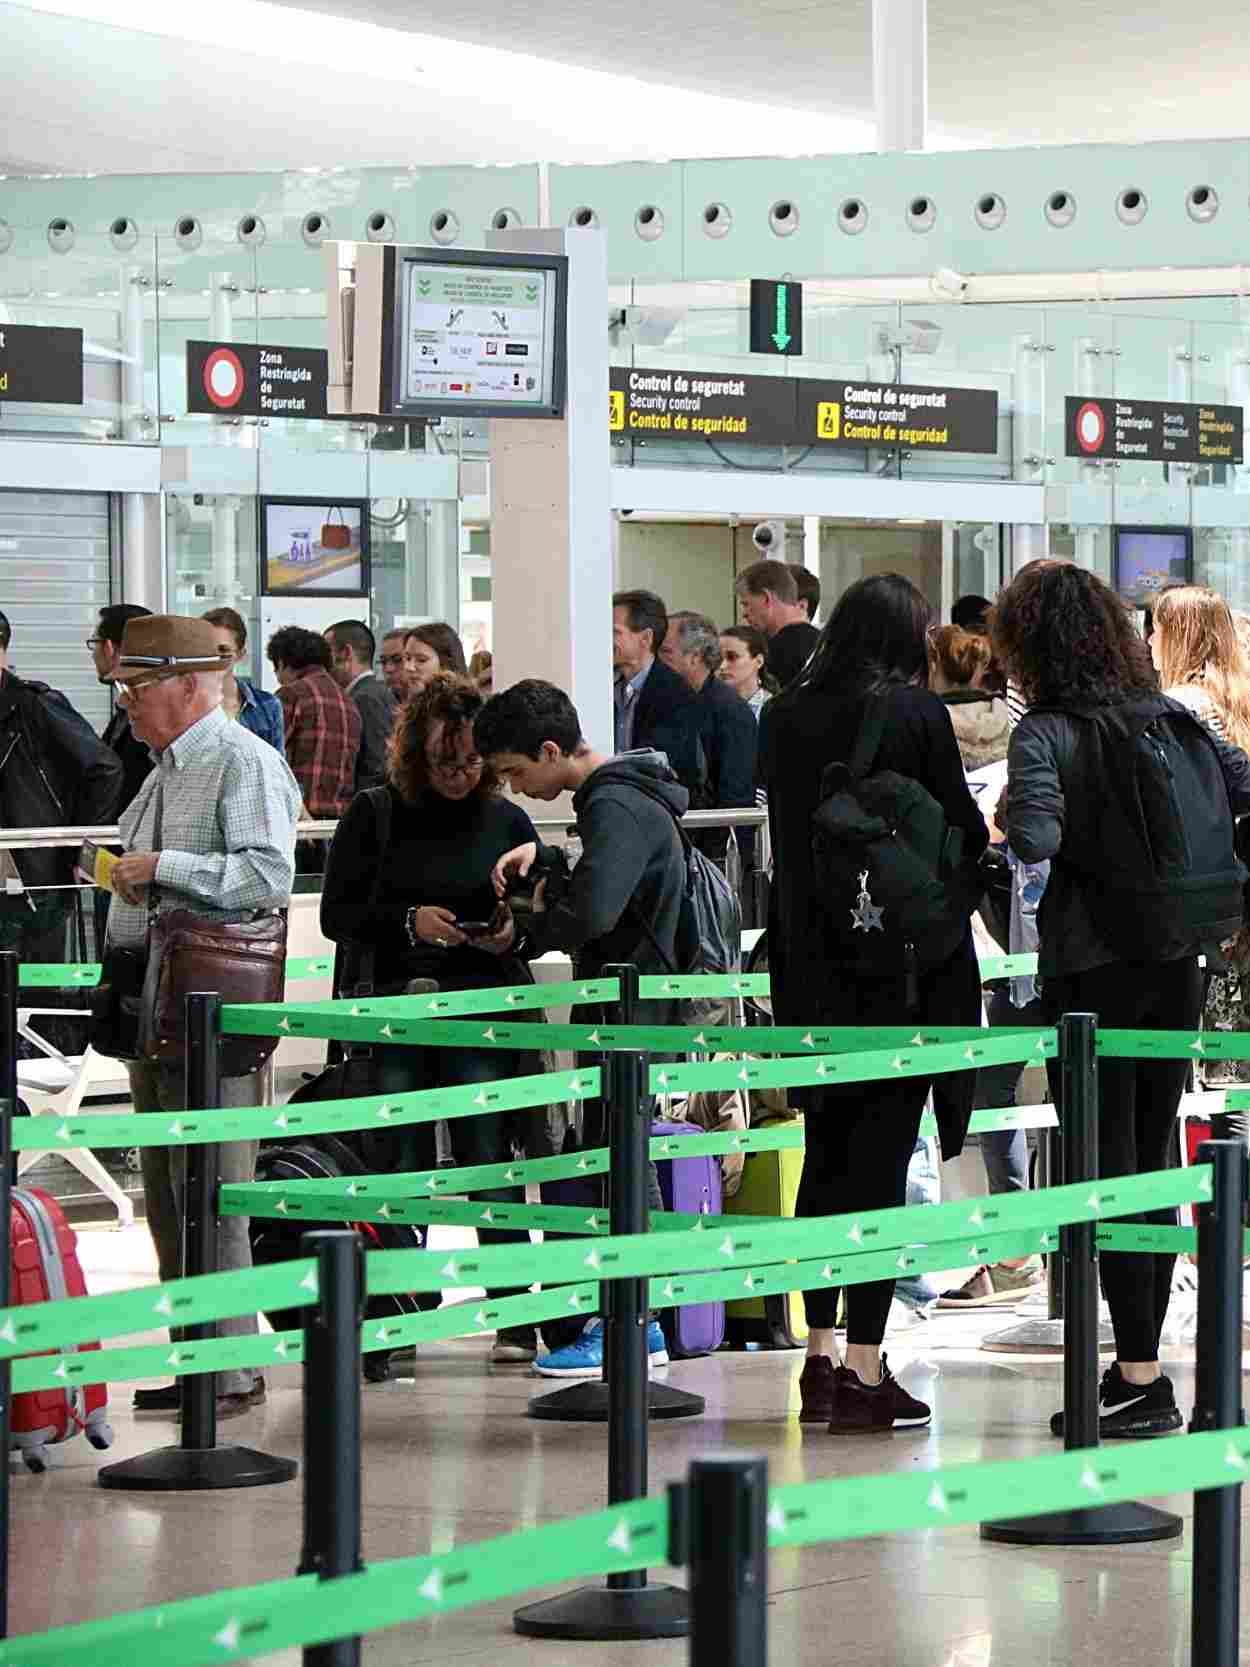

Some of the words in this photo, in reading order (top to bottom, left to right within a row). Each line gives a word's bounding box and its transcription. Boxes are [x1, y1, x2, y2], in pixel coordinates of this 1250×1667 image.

[260, 350, 282, 364] Zona
[260, 365, 312, 383] Restringida
[260, 380, 272, 393] de
[629, 373, 671, 391] Control
[674, 375, 688, 392] de
[691, 380, 745, 397] seguretat
[260, 395, 306, 411] Seguretat
[630, 393, 667, 411] Security
[669, 397, 701, 411] control
[844, 386, 882, 404] Control
[884, 388, 898, 405] de
[899, 392, 946, 408] seguretat
[629, 411, 671, 429] Control
[674, 414, 688, 430] de
[691, 416, 747, 434] seguridad
[844, 405, 876, 422] Security
[878, 407, 906, 422] control
[844, 422, 881, 439] Control
[884, 425, 896, 440] de
[899, 427, 947, 444] seguridad
